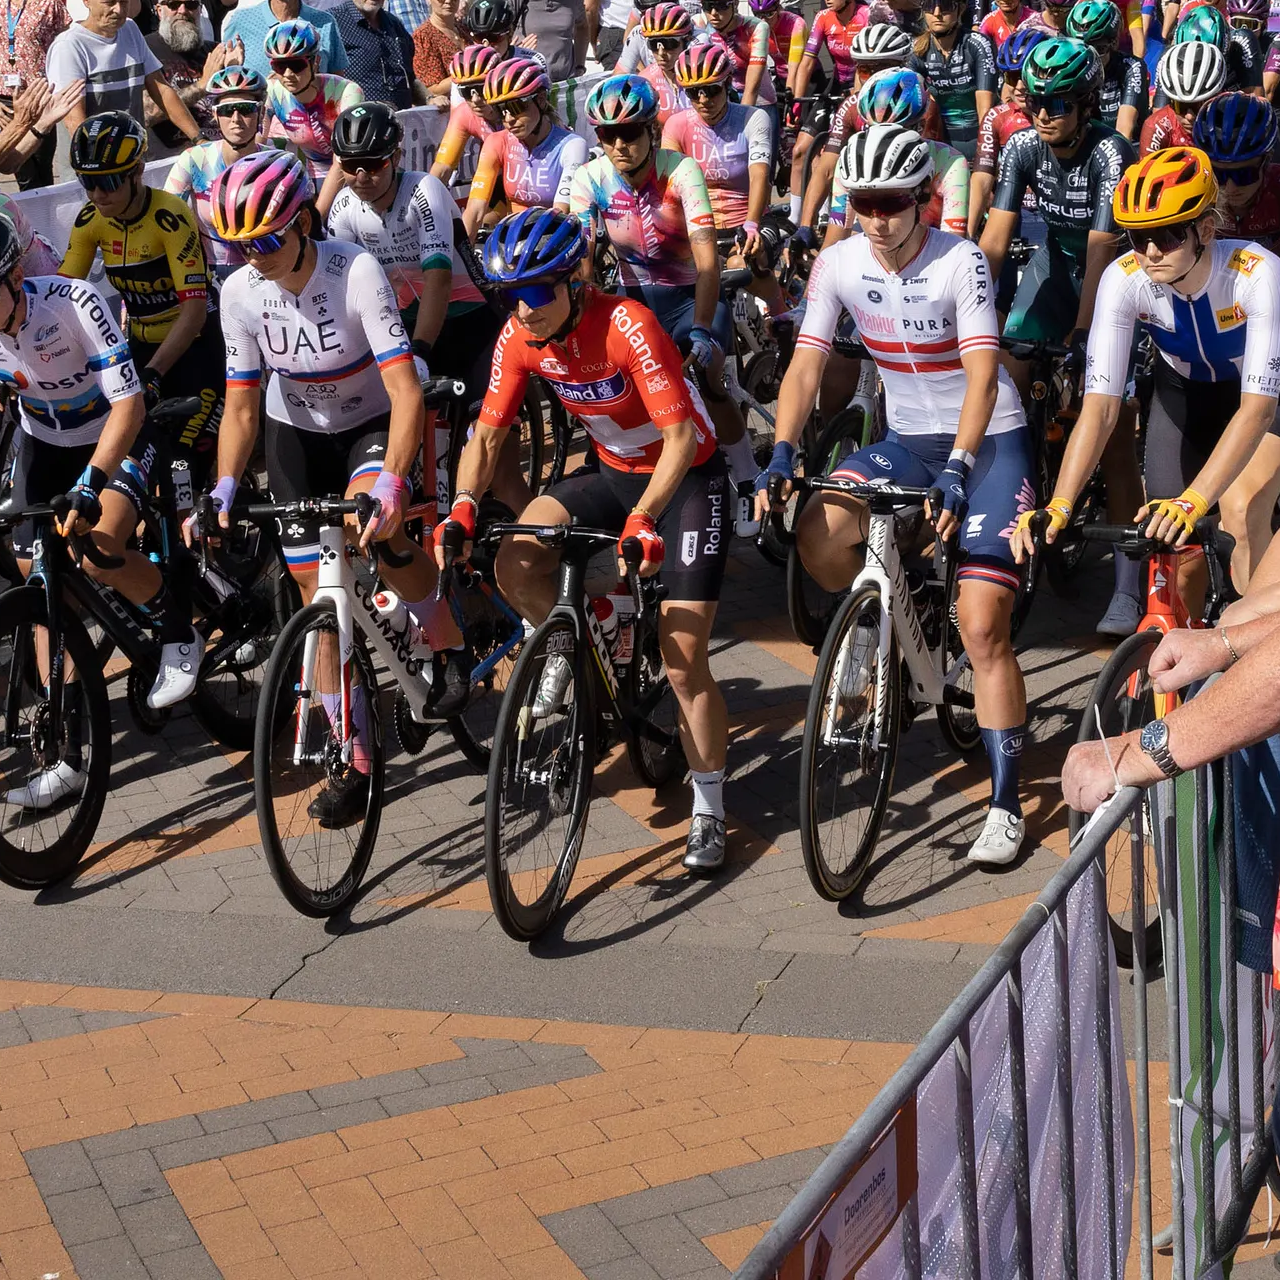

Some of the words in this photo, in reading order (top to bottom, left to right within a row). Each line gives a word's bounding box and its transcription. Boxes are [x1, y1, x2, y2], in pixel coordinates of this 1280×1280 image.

[981, 109, 998, 153] Roland
[1147, 128, 1167, 153] land
[692, 143, 735, 163] UAE
[903, 146, 923, 174] MET
[507, 162, 550, 188] UAE
[267, 183, 287, 218] MET
[176, 231, 197, 263] JUMBO
[971, 251, 987, 306] PURA
[44, 282, 119, 347] youfone
[902, 317, 952, 331] PURA
[264, 319, 341, 356] UAE
[610, 305, 663, 374] Roland
[489, 319, 516, 394] Roland
[580, 360, 615, 374] COGEAS
[37, 365, 91, 391] DSM
[179, 387, 217, 449] JUMBO
[481, 405, 504, 418] GEAS
[649, 400, 686, 418] COGEAS
[140, 442, 157, 474] DSM
[179, 480, 192, 502] 31
[438, 480, 449, 505] 52
[703, 493, 722, 555] Roland
[354, 579, 418, 677] COLNAGO
[844, 1167, 886, 1227] Doorenbos
